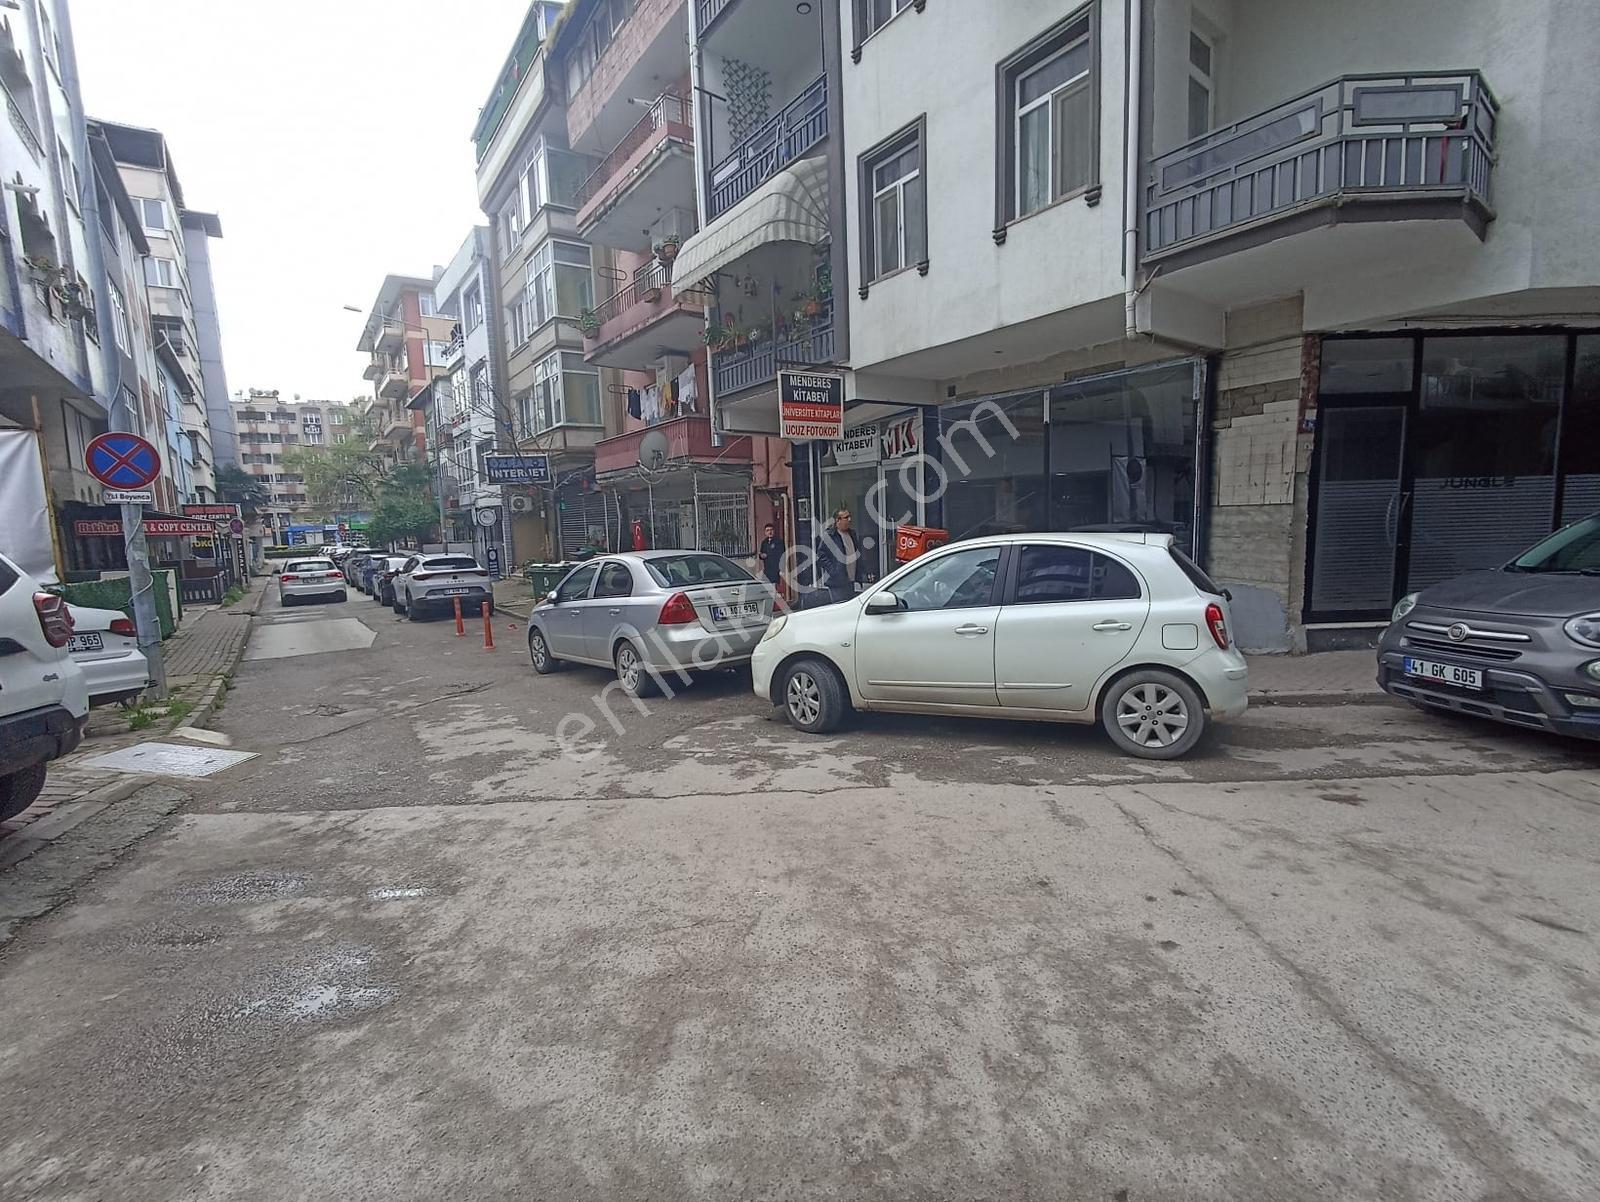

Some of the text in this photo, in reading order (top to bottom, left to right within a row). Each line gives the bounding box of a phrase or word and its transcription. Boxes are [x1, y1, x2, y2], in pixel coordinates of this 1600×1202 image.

[789, 375, 831, 388] MENDERES
[793, 388, 829, 403] KİTABEVİ
[785, 424, 839, 437] UCUZ FOTOKOPİ
[843, 425, 876, 440] NDERES
[836, 436, 873, 453] KİTABEVİ
[158, 523, 179, 532] COPY
[180, 523, 212, 532] CENTER
[80, 635, 99, 646] 965
[1411, 660, 1476, 684] 41 GK 605
